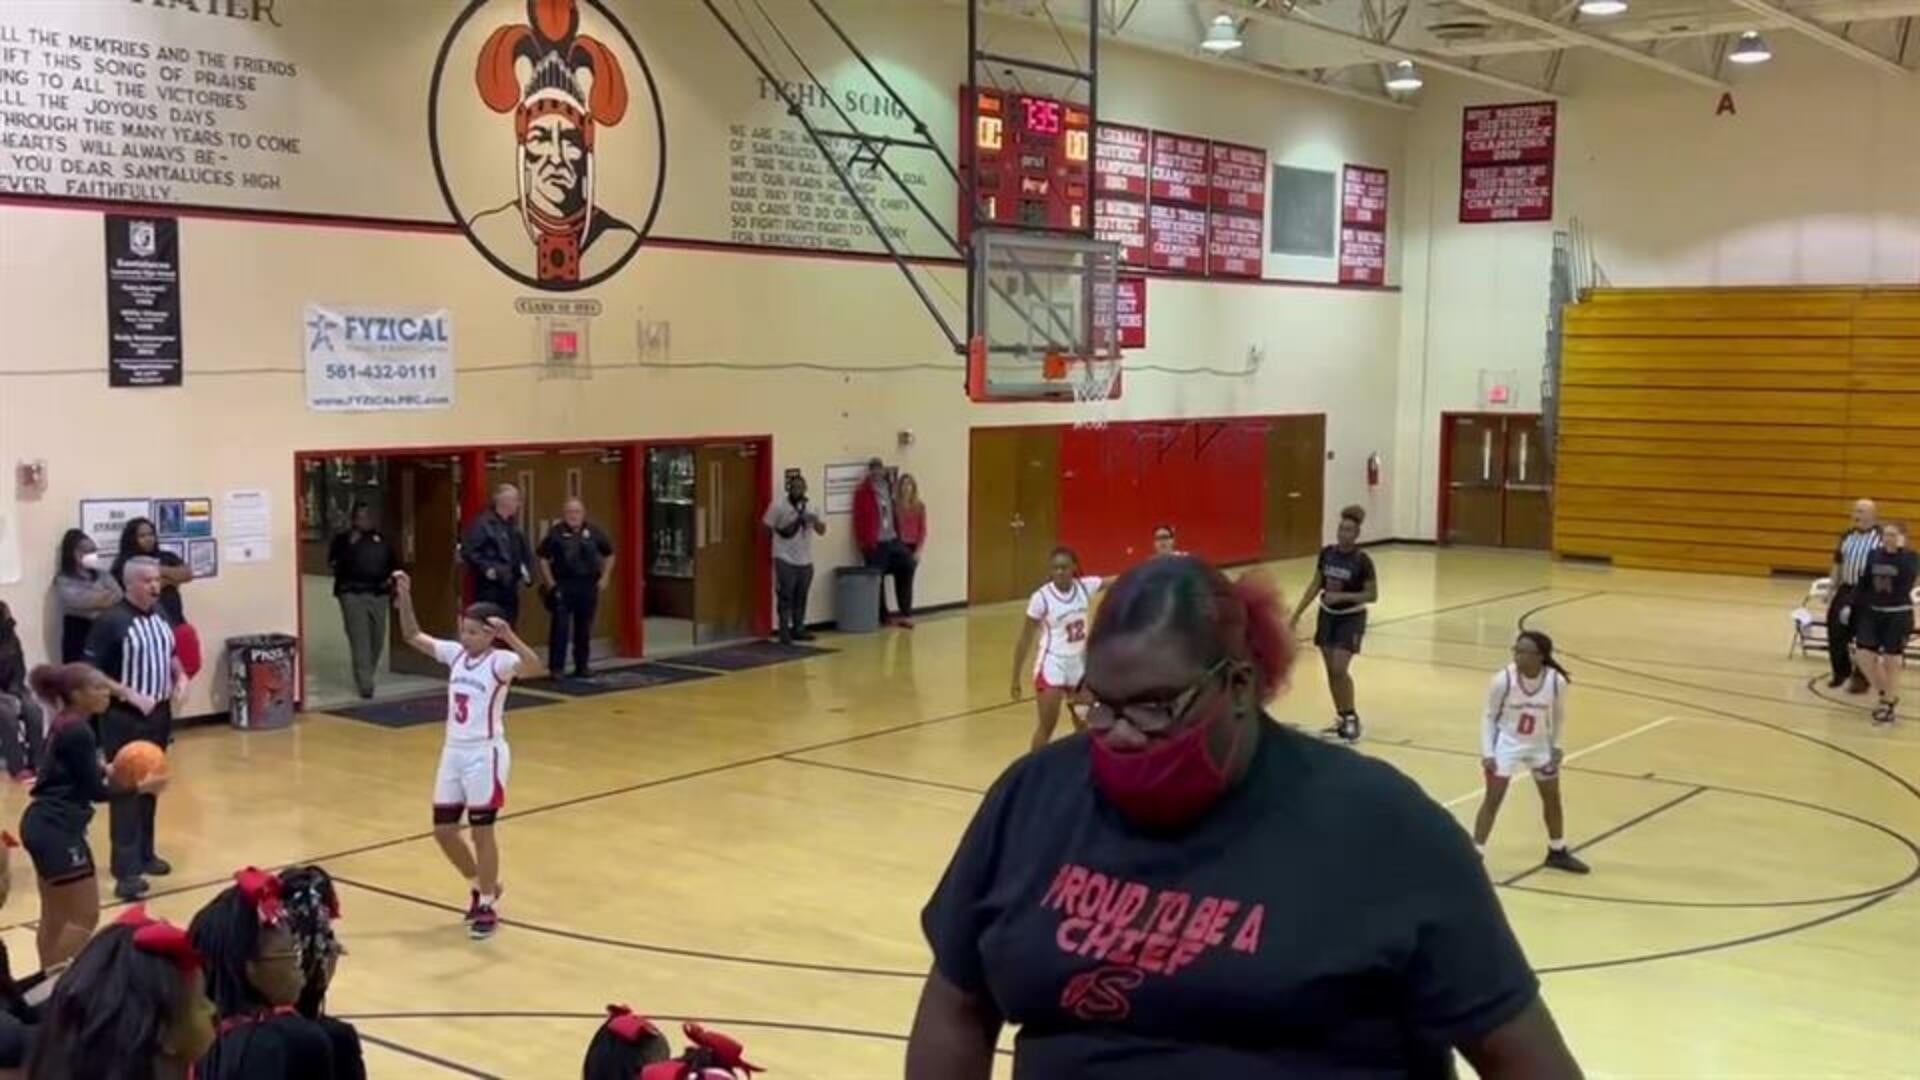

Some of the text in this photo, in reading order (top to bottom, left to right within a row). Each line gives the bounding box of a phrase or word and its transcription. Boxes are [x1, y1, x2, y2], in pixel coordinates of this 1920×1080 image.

[29, 28, 60, 47] THE
[156, 46, 191, 64] AND
[197, 50, 226, 69] THE
[234, 55, 297, 77] FRIENDS
[43, 52, 81, 70] THIS
[94, 57, 147, 79] SONG
[159, 66, 183, 81] OF
[195, 70, 257, 91] PRAISE
[37, 72, 64, 89] TO
[72, 77, 105, 94] ALL
[115, 81, 146, 99] THE
[157, 86, 248, 111] VICTORIES
[1715, 92, 1737, 116] A
[37, 93, 69, 111] THE
[85, 99, 158, 121] JOYOUS
[170, 107, 216, 126] DAYS
[80, 139, 116, 157] WILL
[121, 143, 185, 163] ALWAYS
[83, 118, 115, 136] THE
[121, 123, 167, 139] MANY
[172, 127, 223, 147] YEARS
[228, 132, 251, 149] TO
[256, 134, 301, 154] COME
[12, 155, 281, 190] YOU DEAR SANTALUCES HIGH
[345, 315, 449, 342] FYZICAL
[325, 363, 436, 380] 561-432-0111
[1065, 618, 1086, 644] 12
[454, 692, 470, 725] 3
[1040, 863, 1265, 954] PROUD TO BE A
[1056, 916, 1206, 976] CHIEF
